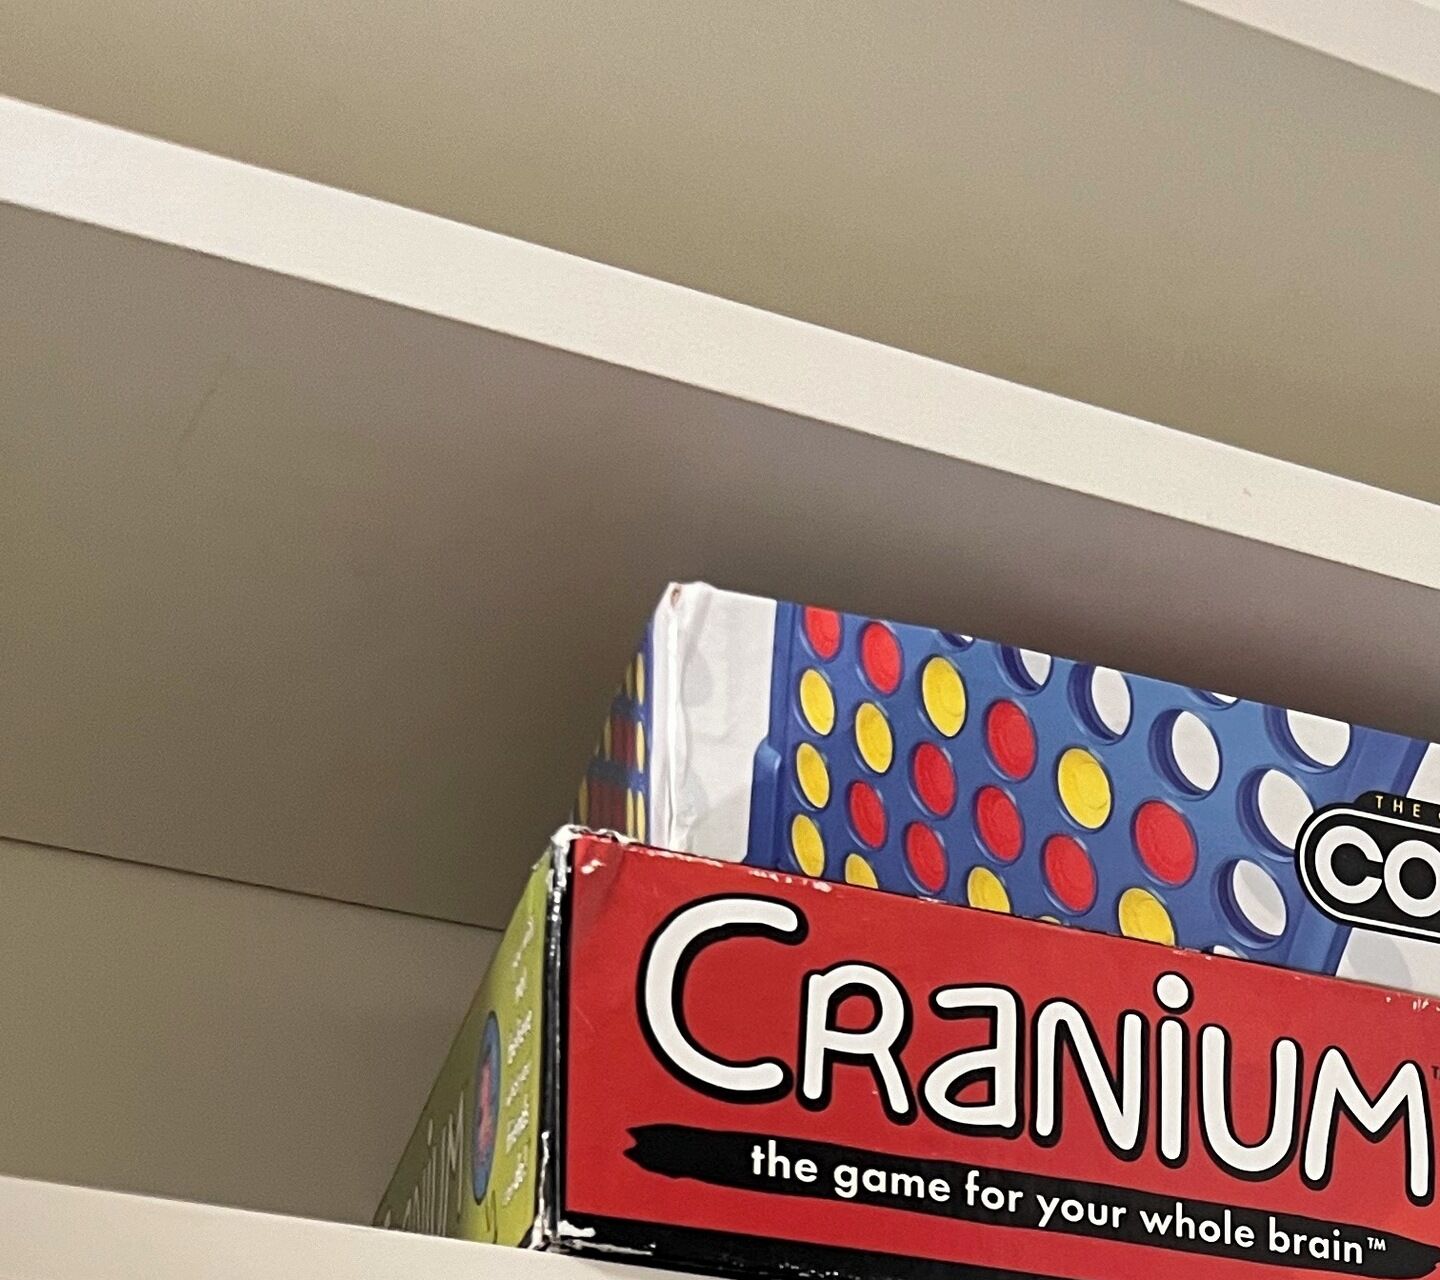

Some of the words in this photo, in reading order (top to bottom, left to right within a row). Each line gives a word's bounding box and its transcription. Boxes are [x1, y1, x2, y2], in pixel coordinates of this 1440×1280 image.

[1376, 794, 1421, 819] THE
[750, 1140, 818, 1184] the
[833, 1154, 952, 1200] game
[963, 1171, 1026, 1214] for
[1035, 1193, 1129, 1231] your
[1139, 1198, 1256, 1252] whole
